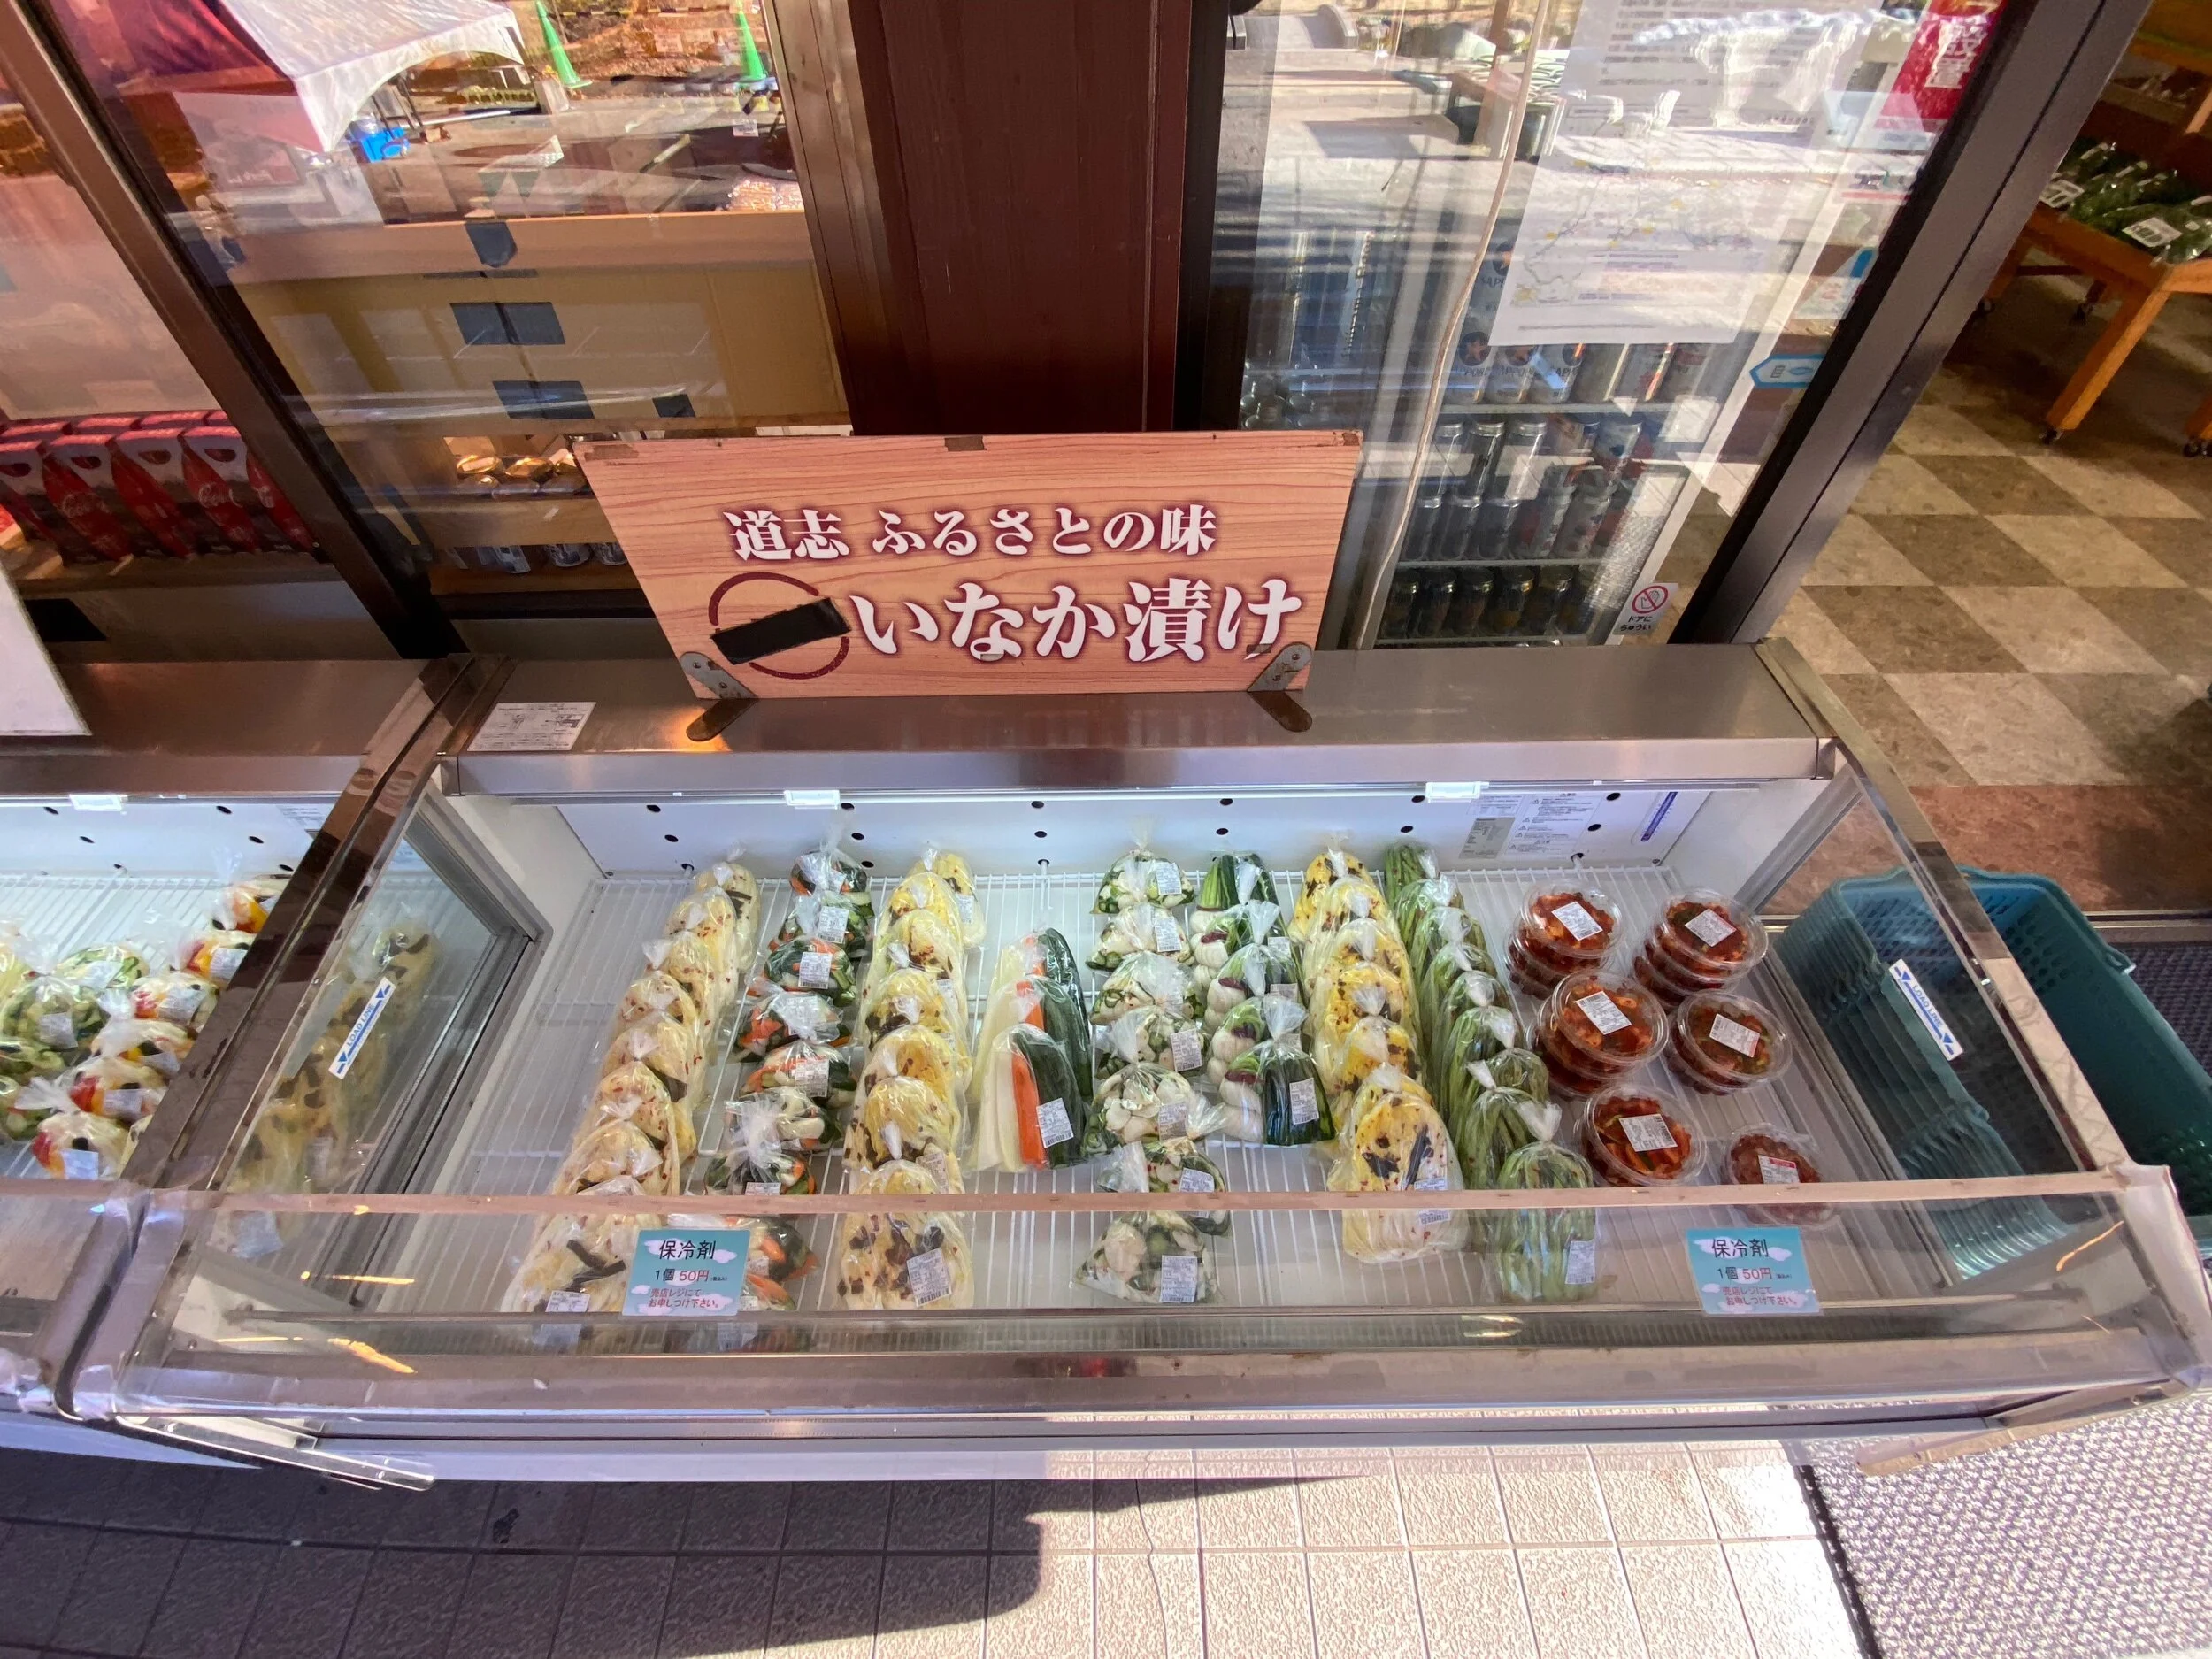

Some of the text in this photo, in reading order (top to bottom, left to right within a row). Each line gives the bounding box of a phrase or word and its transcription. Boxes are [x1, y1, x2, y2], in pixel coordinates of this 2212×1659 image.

[723, 505, 1217, 561] 道志 ふるさとの味
[848, 576, 1304, 663] いなか漬け
[1912, 985, 1943, 1027] LOAD LINE
[347, 1003, 375, 1046] LOAD LINE
[659, 1240, 716, 1260] 保冷剤
[1711, 1239, 1769, 1258] 保冷剤
[655, 1269, 675, 1281] 1個
[679, 1270, 709, 1282] 50円
[1717, 1267, 1739, 1279] 1個
[1742, 1267, 1772, 1280] 50円
[650, 1288, 702, 1297] 売店レジにて
[648, 1298, 719, 1308] お申しつけ下さい。
